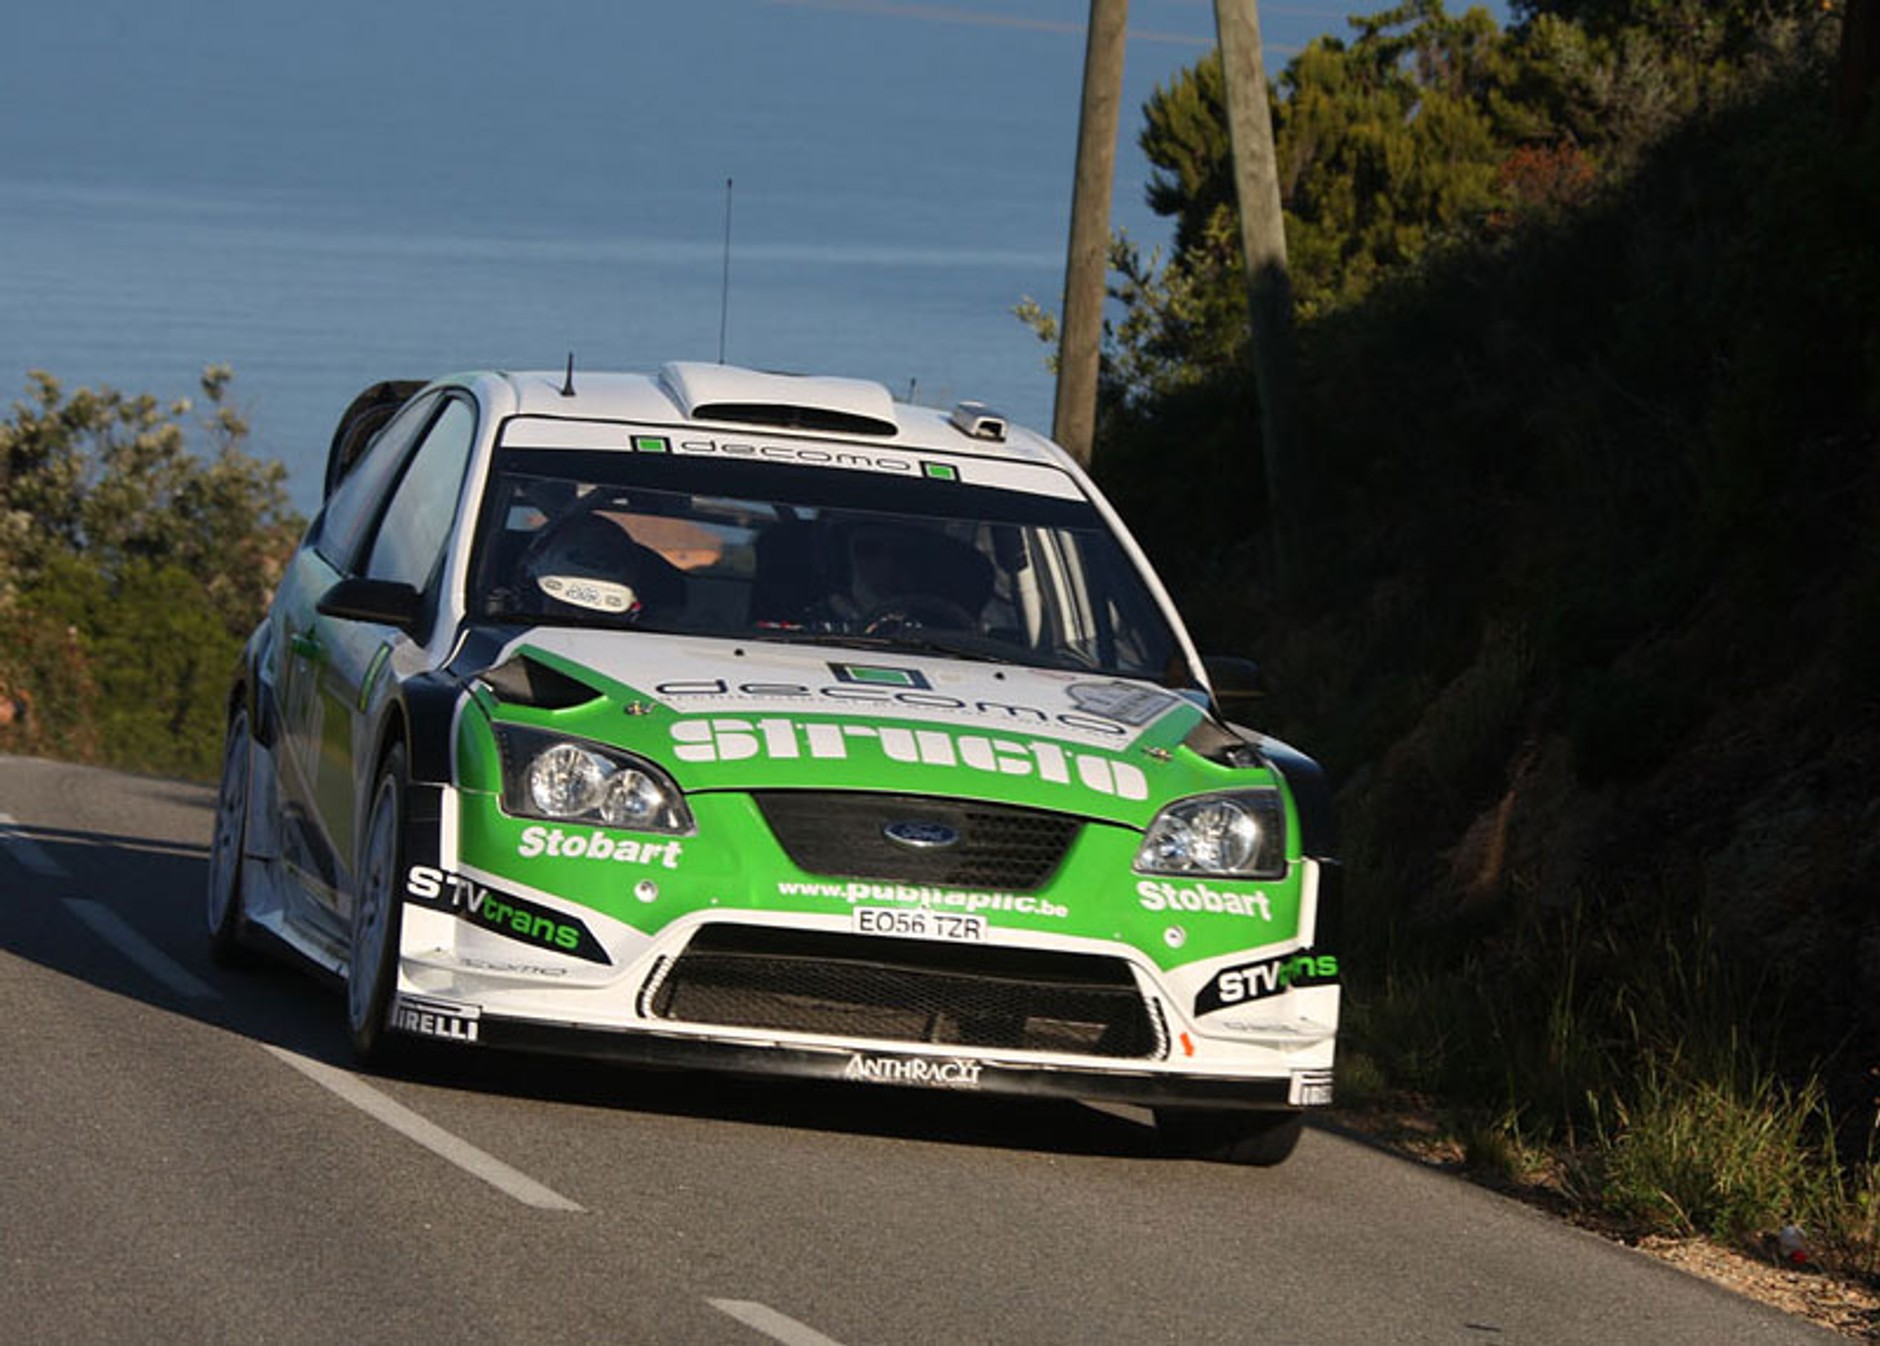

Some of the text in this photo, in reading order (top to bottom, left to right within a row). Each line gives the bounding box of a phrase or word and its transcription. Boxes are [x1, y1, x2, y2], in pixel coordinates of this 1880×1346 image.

[681, 440, 911, 471] decomo
[655, 679, 1126, 735] decomo
[518, 826, 684, 869] Stobart
[1136, 880, 1272, 922] Stobart
